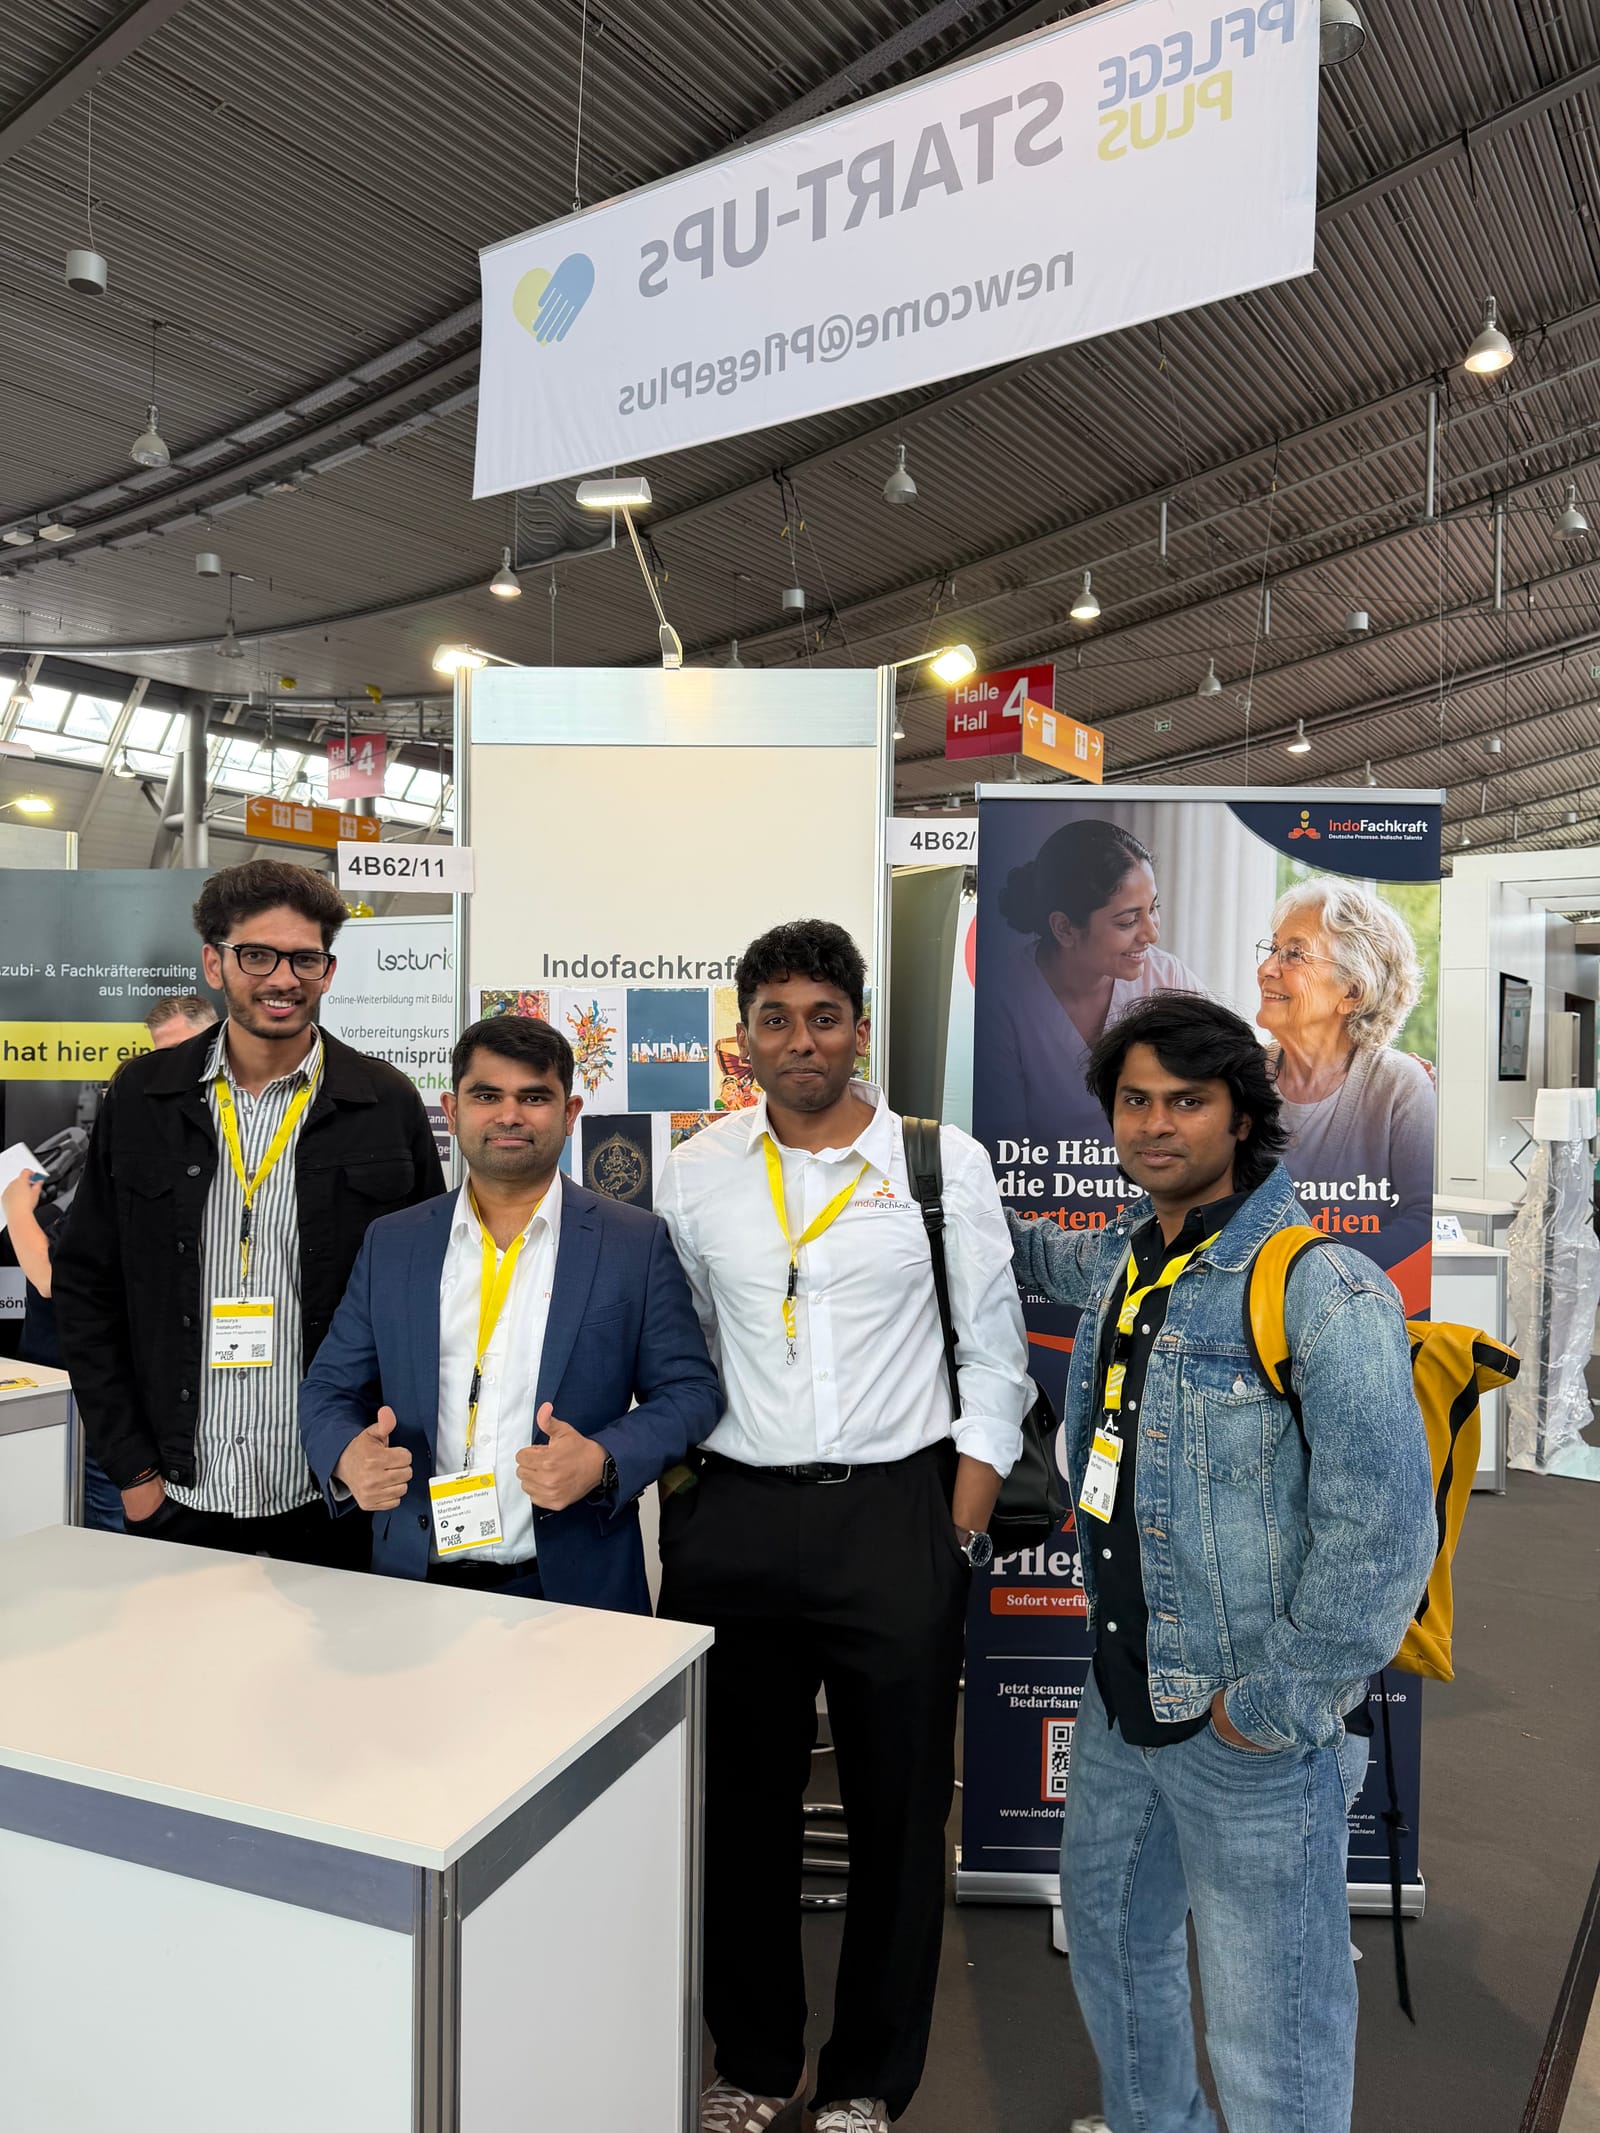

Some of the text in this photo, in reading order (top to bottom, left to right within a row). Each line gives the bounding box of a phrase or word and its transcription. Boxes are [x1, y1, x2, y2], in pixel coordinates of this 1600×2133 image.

[955, 677, 1029, 724] Halle 4
[954, 711, 987, 732] Hall
[358, 742, 375, 776] 4
[1328, 819, 1428, 833] IndoFachkraft
[910, 831, 976, 850] 4B62/
[348, 856, 444, 877] 4B62/11
[0, 963, 197, 981] zubi- & Fachkräfterecruiting
[99, 984, 197, 996] aus Indonesien
[328, 994, 413, 1006] Online-Weiterbildung
[415, 994, 429, 1004] mit
[340, 1025, 449, 1041] Vorbereitungskurs
[4, 1040, 48, 1062] hat
[58, 1040, 109, 1062] hier
[632, 1042, 706, 1063] INDIA
[997, 1138, 1049, 1165] Die
[997, 1170, 1149, 1198] die Deuts
[1006, 1593, 1088, 1607] Sofort verfü
[997, 1683, 1030, 1696] Jetzt
[1009, 1696, 1082, 1709] Bedarfsan
